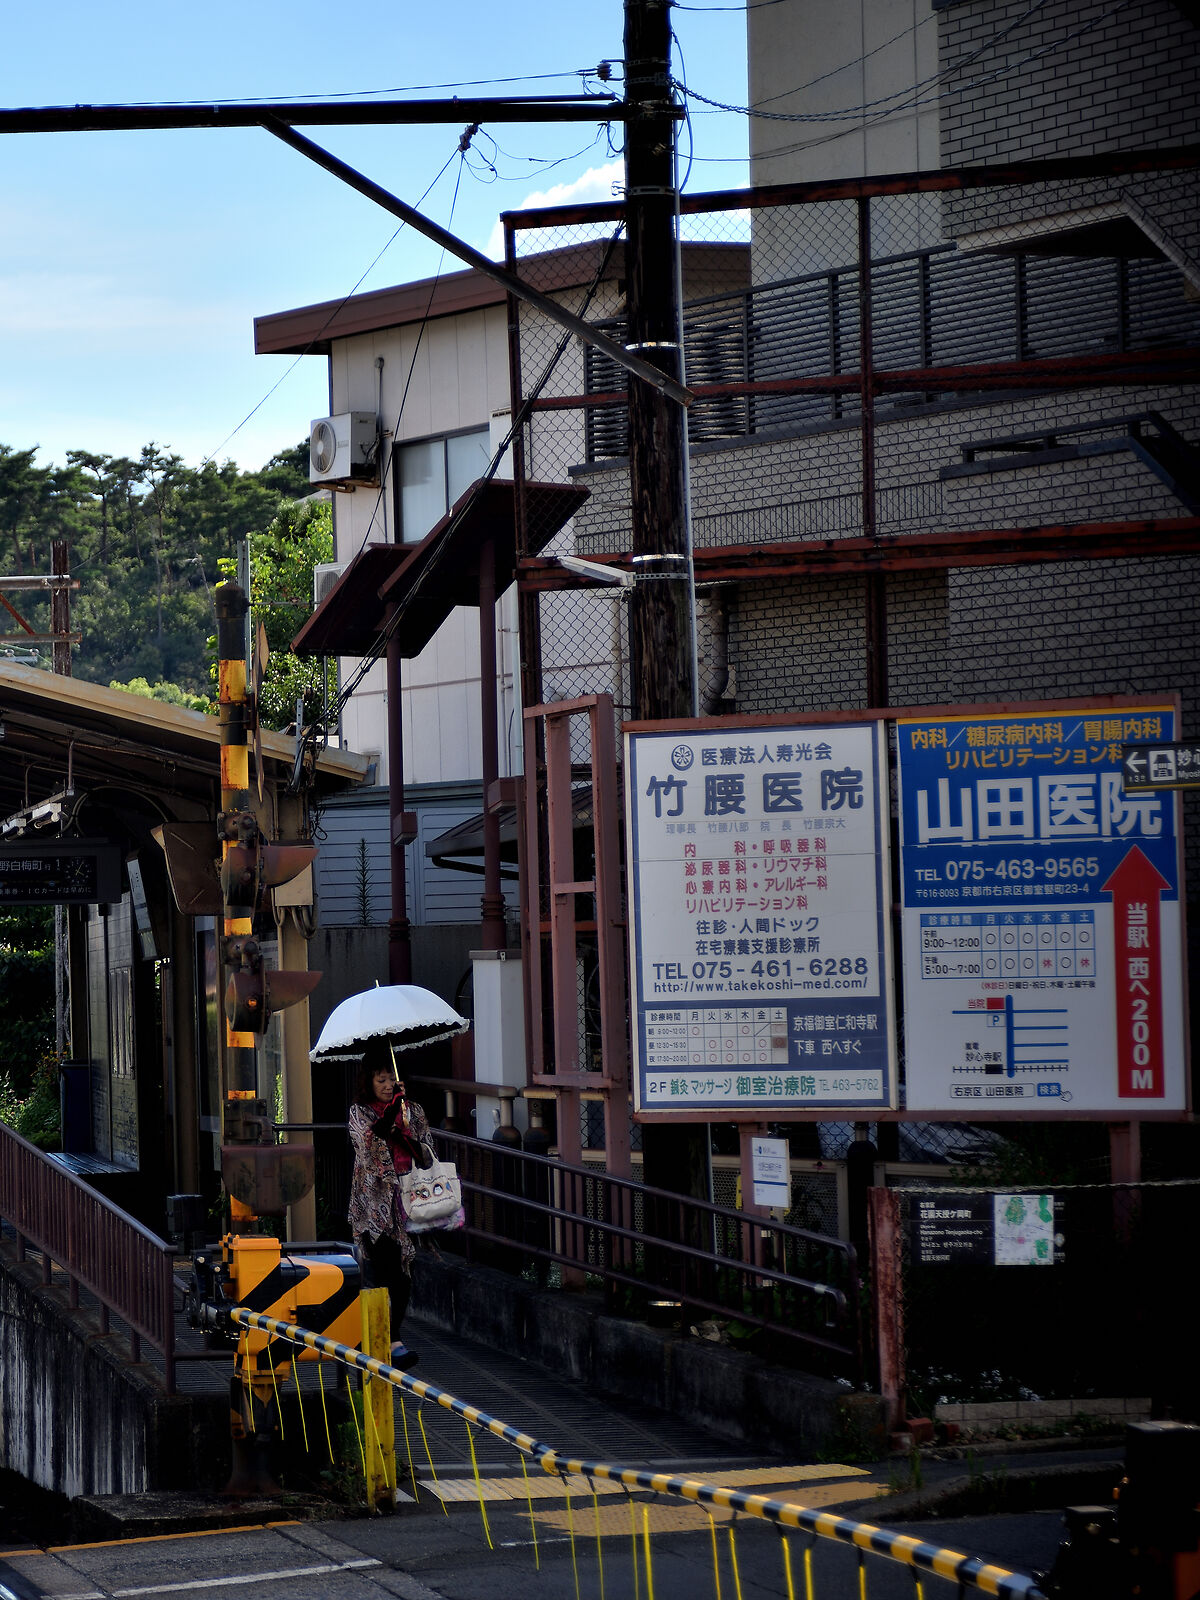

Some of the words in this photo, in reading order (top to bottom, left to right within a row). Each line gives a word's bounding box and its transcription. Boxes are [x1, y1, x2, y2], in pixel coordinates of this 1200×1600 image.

[701, 742, 832, 766] 医療法人寿光会
[945, 743, 1123, 770] リハビリテーション科
[646, 766, 864, 818] 竹腰医院
[917, 772, 1162, 844] 山田医院
[915, 868, 942, 881] TEL
[945, 857, 1100, 881] 075-463-9565
[686, 894, 808, 914] リハビリテーション科
[696, 917, 819, 935] 往診・人間ドック
[986, 914, 995, 925] 月
[1080, 912, 1089, 923] 土
[1127, 902, 1149, 949] 当駅
[696, 937, 820, 955] 在宅療養支援診療所
[653, 963, 688, 980] TEL
[654, 977, 867, 993] http://www.takekoshi-med.com/
[650, 1012, 681, 1021] 診療時間
[691, 1011, 699, 1020] 月
[708, 1011, 716, 1020] 火
[724, 1011, 733, 1020] 水
[741, 1010, 749, 1019] 木
[757, 1010, 766, 1019] 金
[775, 1010, 783, 1019] 土
[793, 1014, 878, 1032] 京福御室仁和寺駅
[992, 1015, 1000, 1026] P
[794, 1040, 815, 1056] 下車
[821, 1040, 862, 1056] 西へすぐ
[965, 1051, 1002, 1062] 妙心寺駅
[649, 1082, 667, 1093] 2F
[670, 1079, 689, 1096] 鍼灸
[691, 1079, 732, 1095] マッサージ
[736, 1075, 816, 1097] 御室治療院
[819, 1080, 830, 1092] TEL
[832, 1078, 879, 1093] 463-5762
[954, 1086, 983, 1097] 右京区
[986, 1085, 1024, 1097] 山田医院
